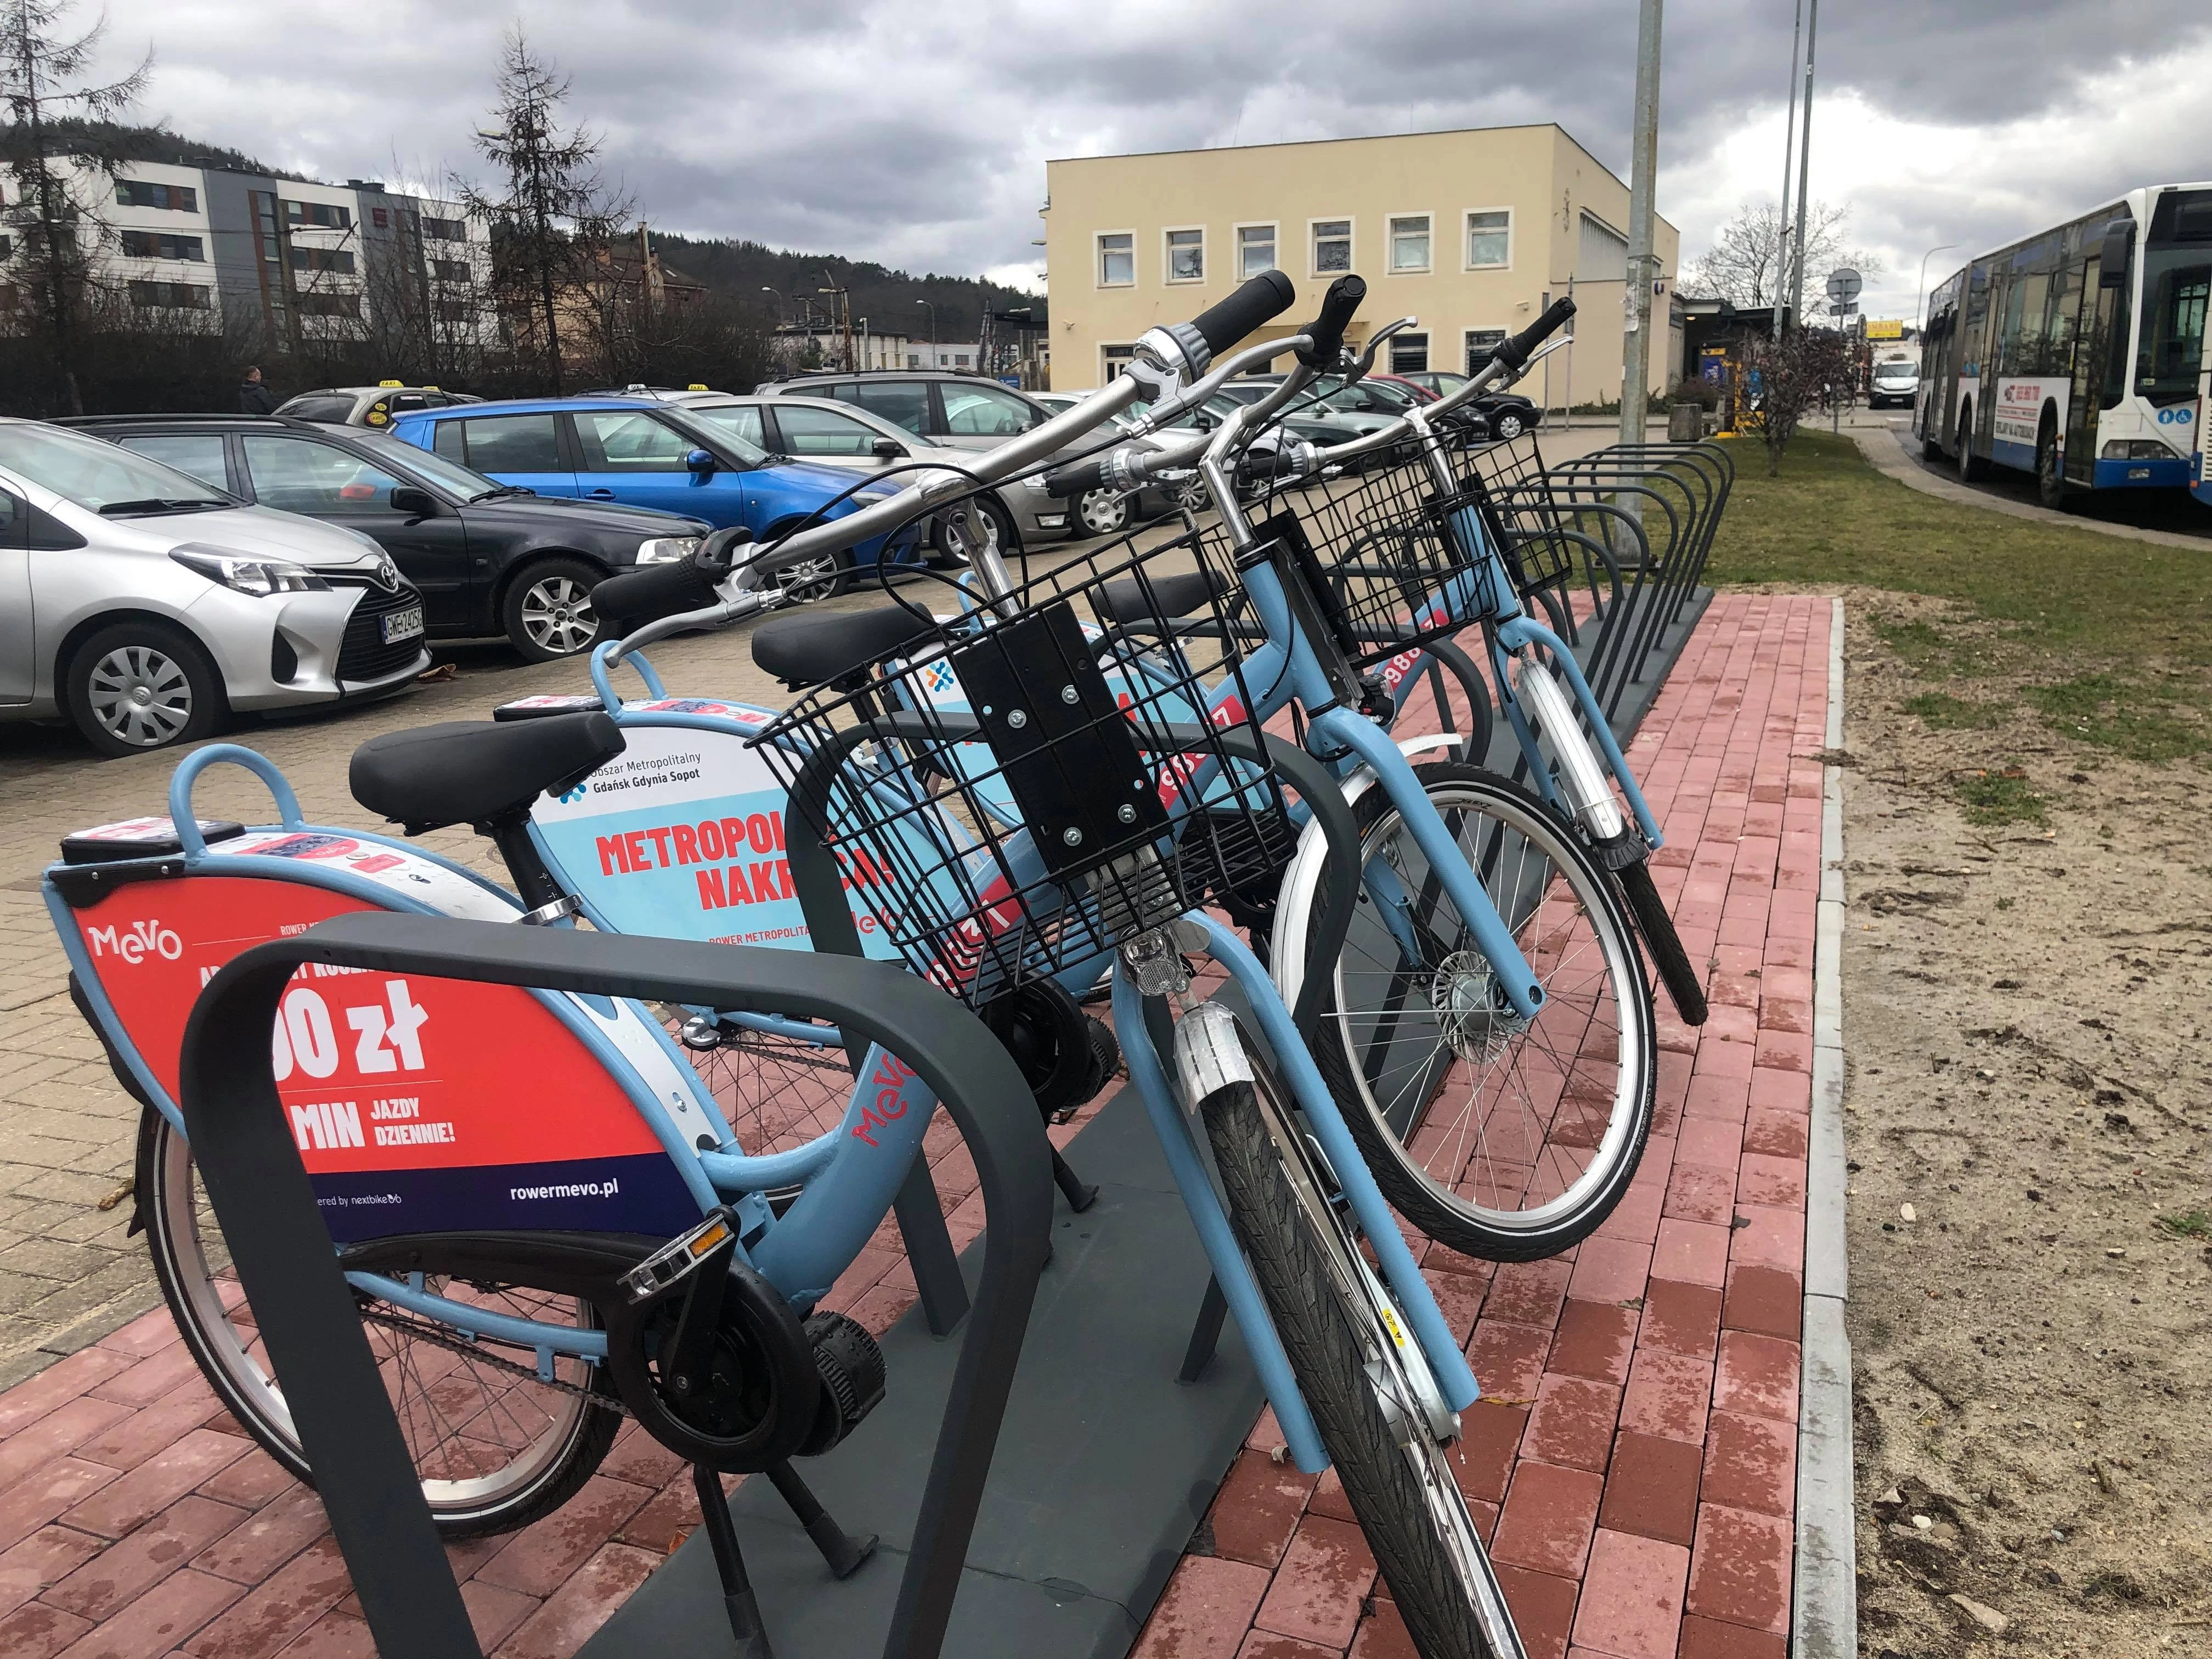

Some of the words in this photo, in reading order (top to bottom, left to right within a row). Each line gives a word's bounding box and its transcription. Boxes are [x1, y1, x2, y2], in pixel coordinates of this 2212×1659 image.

[627, 753, 701, 772] Metropolitalny
[594, 778, 631, 793] Gdańsk
[632, 774, 668, 788] Gdynia
[669, 768, 701, 782] Sopot
[280, 923, 307, 935] ROWER
[746, 926, 810, 943] METROPOLITA
[346, 979, 429, 1074] zł
[370, 1098, 420, 1120] JAZDY
[290, 1102, 365, 1150] MIN
[374, 1122, 456, 1146] DZIENNIE!
[510, 1178, 619, 1200] rowermevo.pl
[317, 1196, 336, 1206] ered
[338, 1196, 348, 1207] by
[351, 1194, 388, 1205] nextbike
